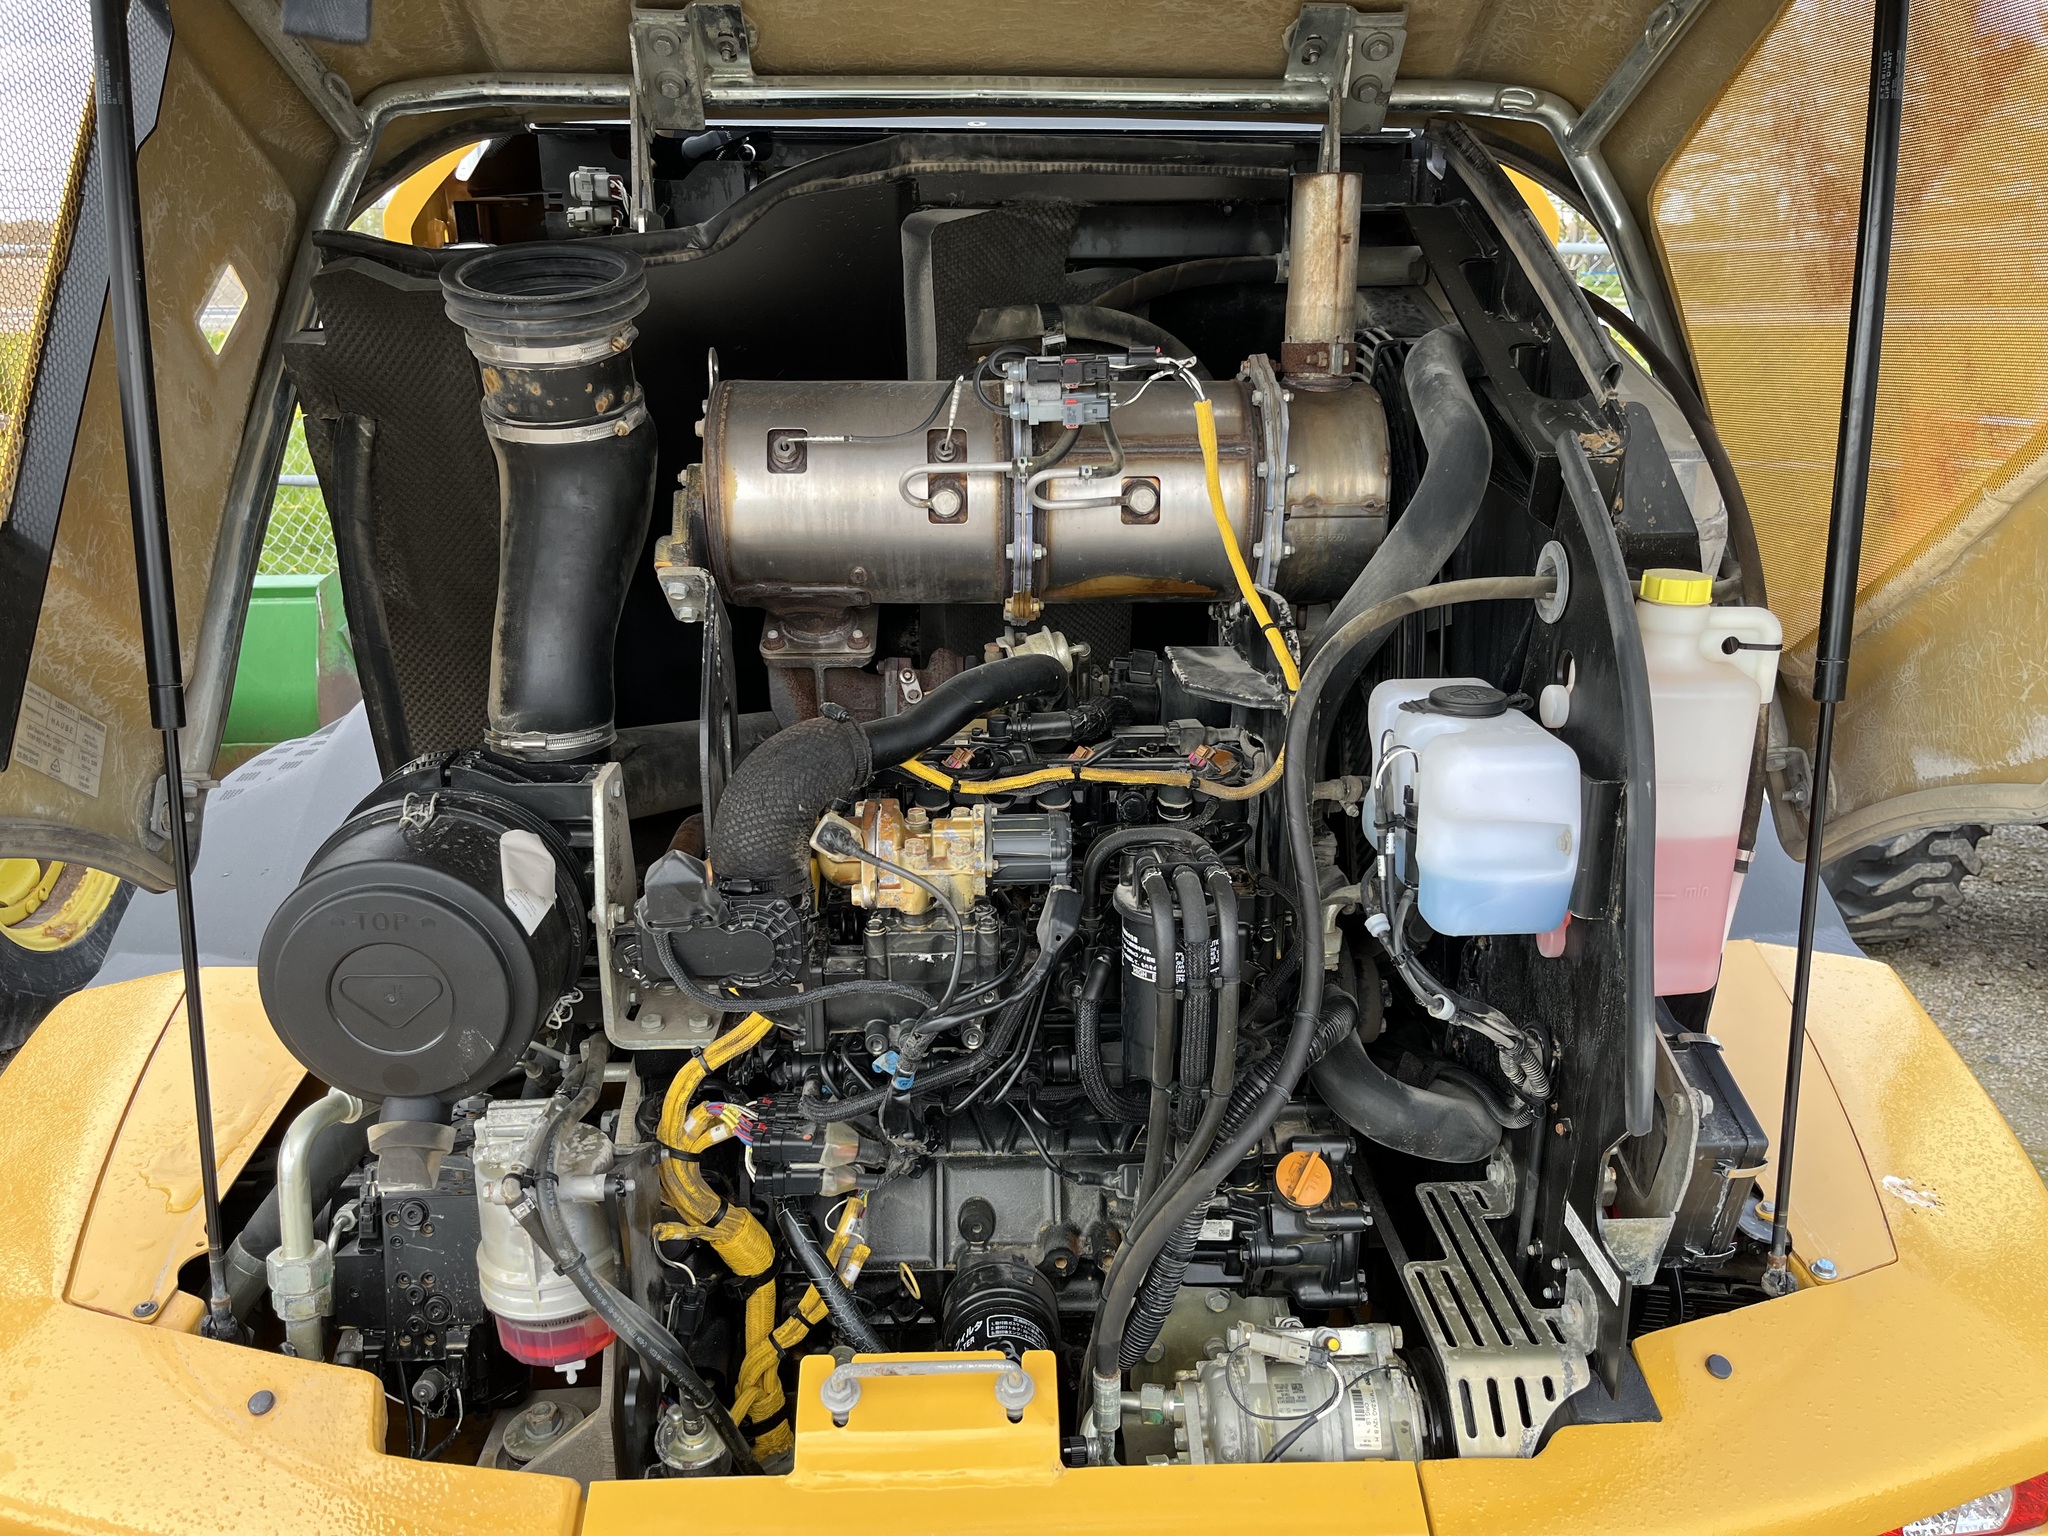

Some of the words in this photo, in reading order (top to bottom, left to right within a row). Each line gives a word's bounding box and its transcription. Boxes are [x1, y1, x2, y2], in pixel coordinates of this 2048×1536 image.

[1880, 51, 1888, 100] STABILUS
[1684, 886, 1709, 899] min
[352, 910, 409, 932] TOP
